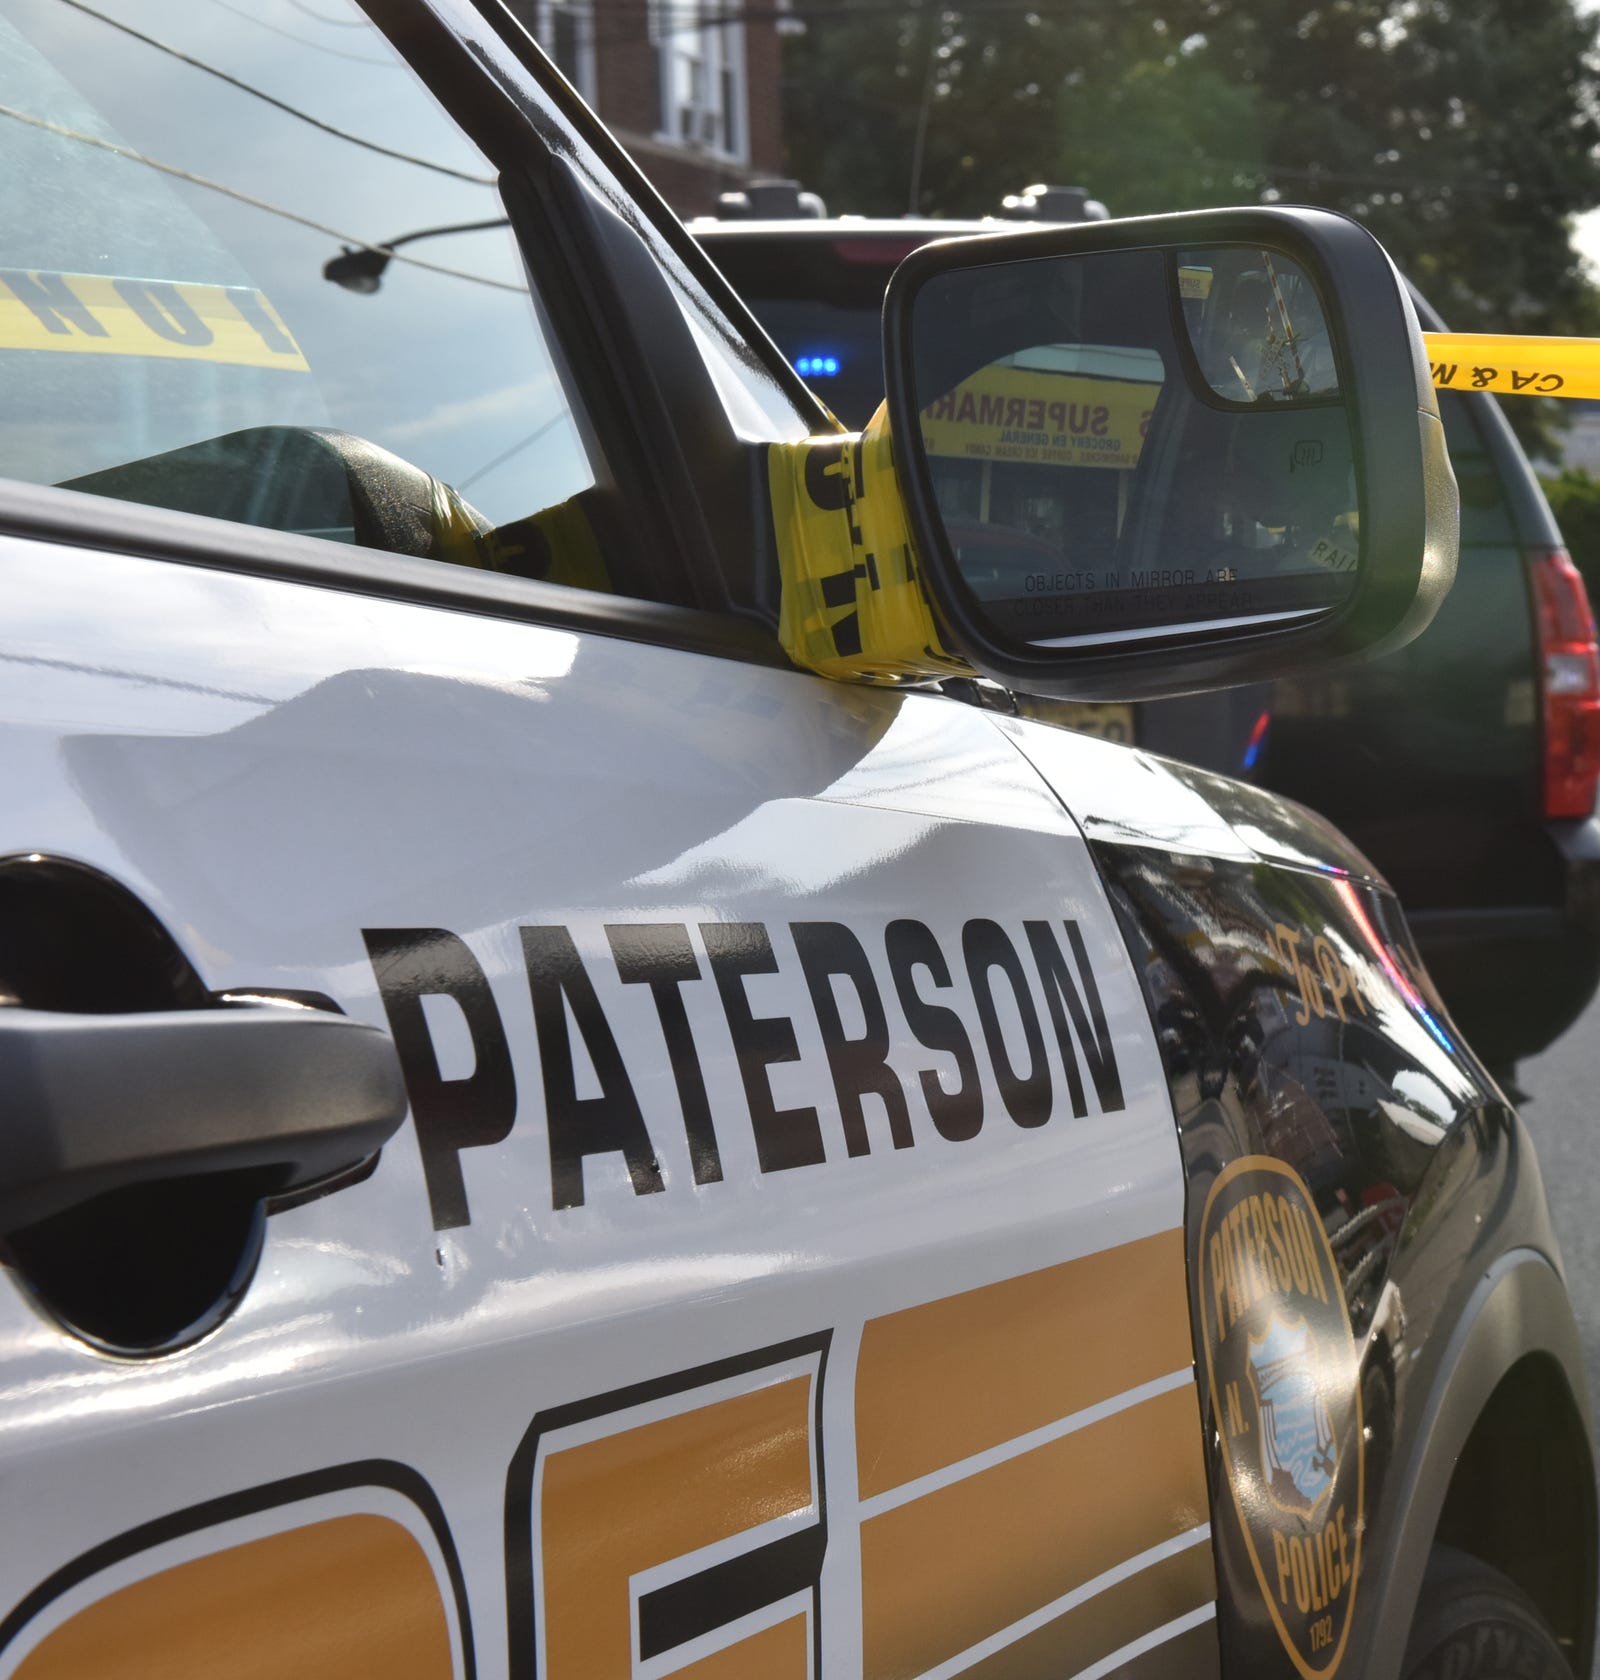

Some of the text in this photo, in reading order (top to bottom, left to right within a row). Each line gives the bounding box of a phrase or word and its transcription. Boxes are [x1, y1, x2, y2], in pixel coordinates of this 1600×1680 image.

[1471, 366, 1499, 388] &
[1511, 370, 1564, 393] CA
[1024, 567, 1239, 592] OBJECTS IN MIRROR ARE
[361, 917, 1125, 1231] PATERSON
[1209, 1191, 1329, 1343] PATERSON
[1272, 1503, 1351, 1615] POLICE
[1309, 1615, 1334, 1653] 1792
